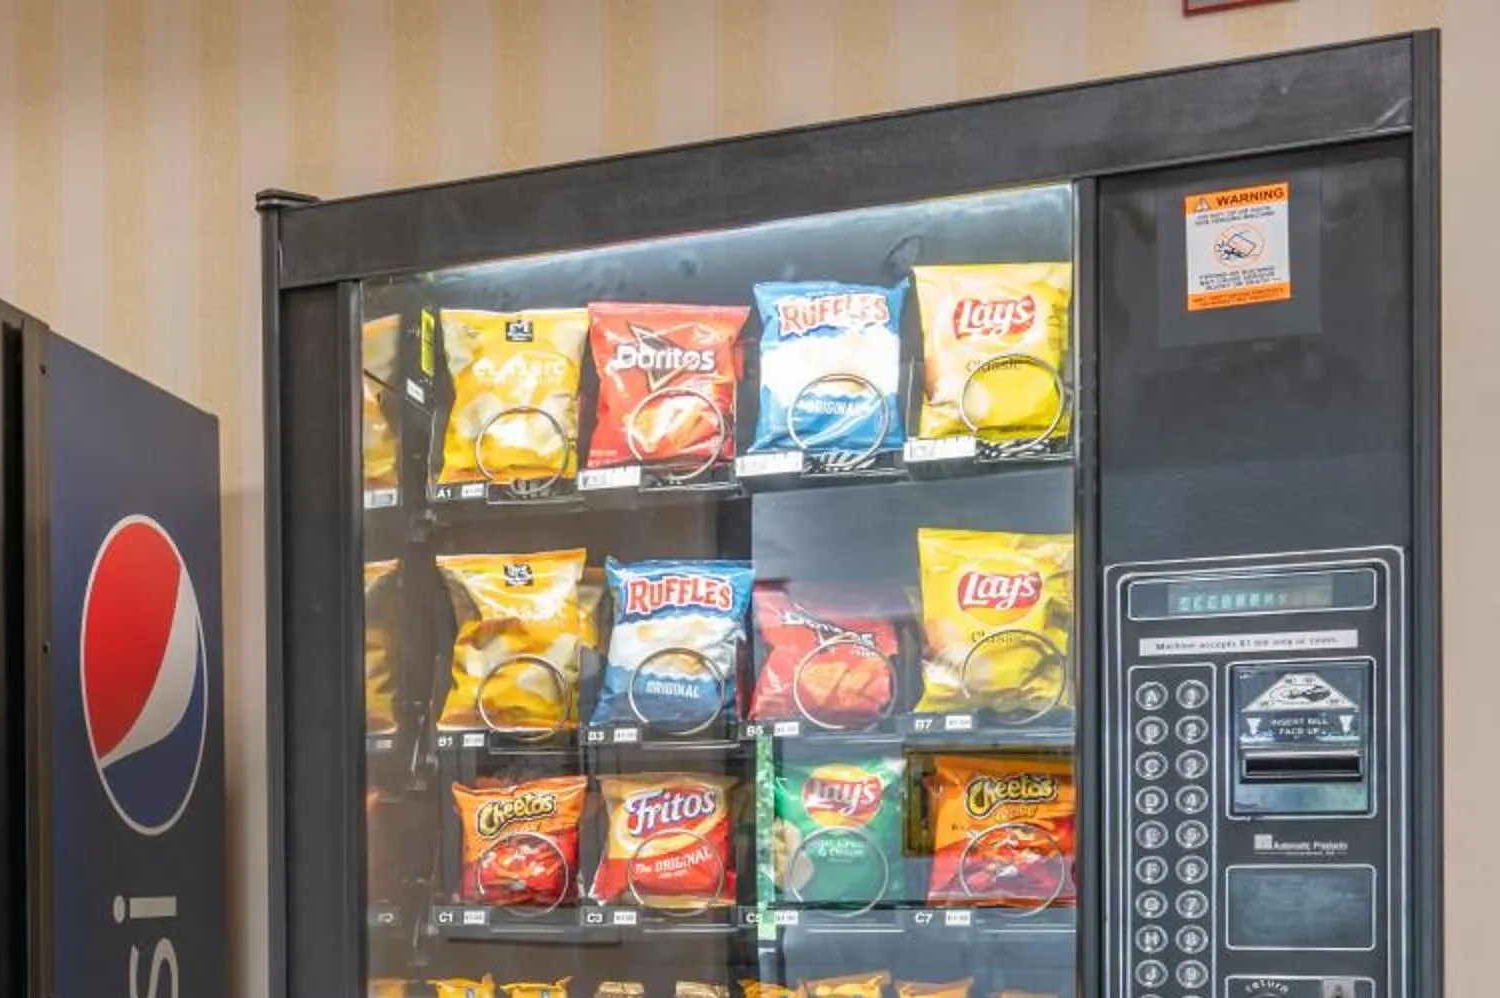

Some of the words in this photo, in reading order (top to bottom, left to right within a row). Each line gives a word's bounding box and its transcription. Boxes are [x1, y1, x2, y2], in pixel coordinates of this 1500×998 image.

[1215, 188, 1285, 206] WARNING
[781, 295, 888, 333] RUFFLES
[616, 343, 715, 371] Doritos
[437, 488, 451, 498] A1
[627, 576, 733, 614] RUFFLES
[968, 776, 1056, 816] Cheetos
[477, 794, 558, 835] Cheetos
[627, 789, 716, 836] Fritos
[655, 846, 712, 873] ORIGINAL
[439, 913, 453, 923] C1
[914, 912, 932, 924] C7
[1245, 979, 1290, 994] return
